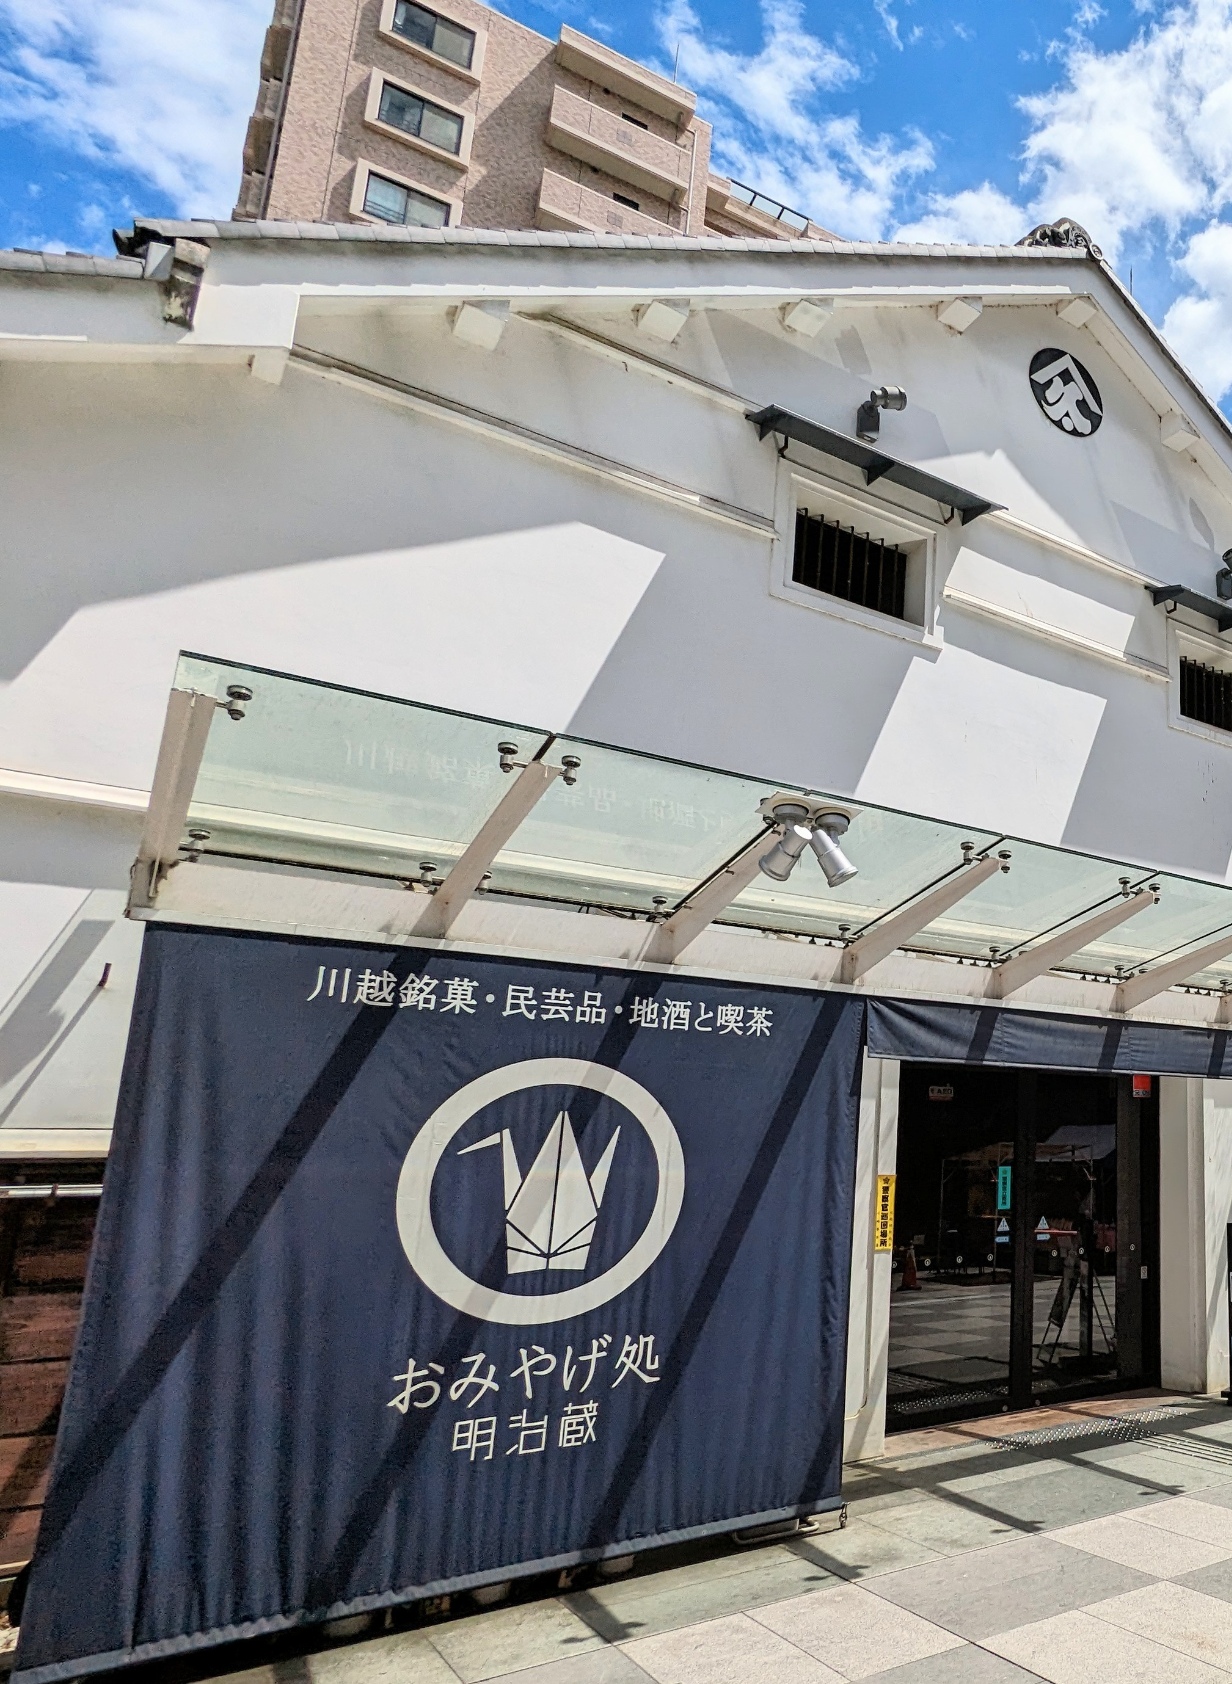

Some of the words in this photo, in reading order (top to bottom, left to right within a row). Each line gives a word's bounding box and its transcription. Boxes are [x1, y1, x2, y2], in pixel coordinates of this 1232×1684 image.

[306, 965, 774, 1038] 川越銘菓・民芸品・地酒と喫茶
[386, 1333, 661, 1415] おみやげ処
[451, 1399, 600, 1462] 明治蔵
